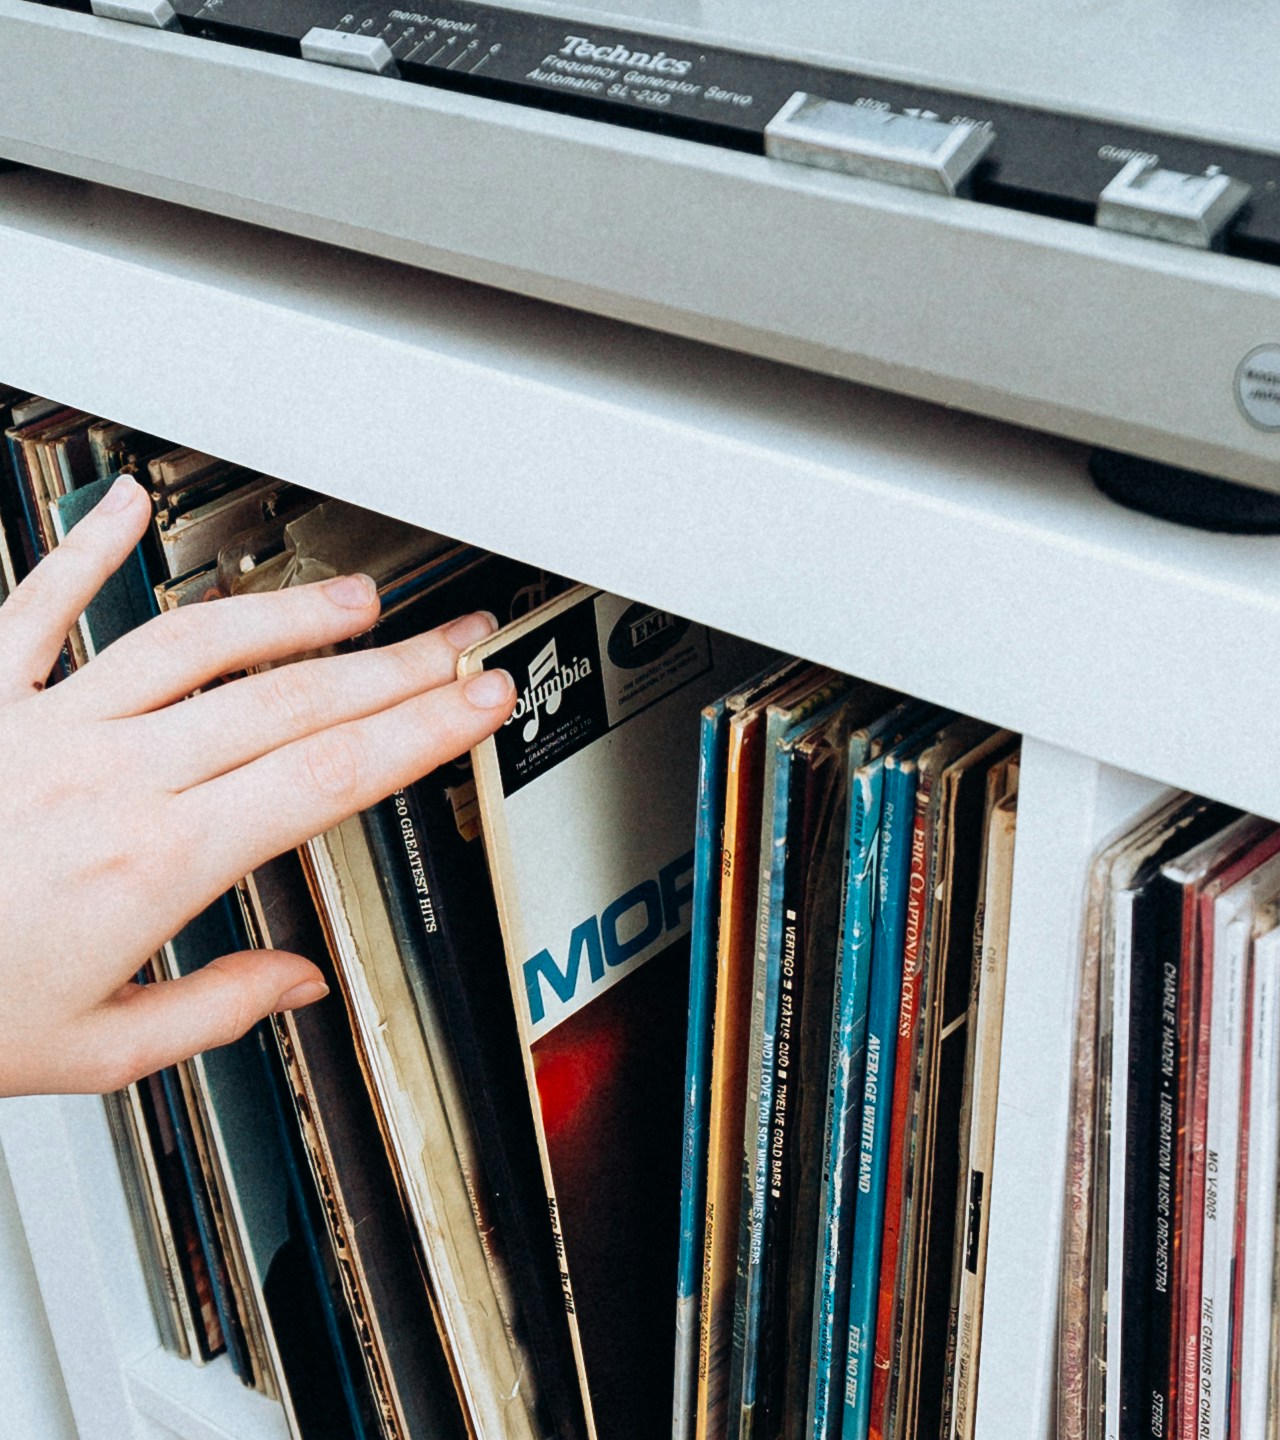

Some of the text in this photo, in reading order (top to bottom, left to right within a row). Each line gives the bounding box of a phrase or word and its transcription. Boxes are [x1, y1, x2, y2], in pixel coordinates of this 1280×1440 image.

[387, 8, 477, 34] memo-repeat
[489, 42, 503, 54] 6
[558, 35, 693, 76] Technics
[525, 67, 671, 106] Automatic SL-230
[540, 54, 753, 107] Frequency Generator Servo
[854, 95, 891, 113] stop
[503, 656, 593, 726] olumbia
[527, 733, 568, 763] GRAMOPHONE
[394, 797, 437, 933] 20 GREATEST HITS
[723, 848, 732, 878] CBS
[910, 828, 925, 871] ERIC
[758, 883, 771, 951] MERCURY
[761, 1032, 774, 1058] AND
[771, 925, 797, 1187] VERTIGO STATUS QUO TWELVE GOLD BARS
[759, 1066, 772, 1097] LOVE
[758, 1099, 771, 1125] YOU
[858, 1032, 881, 1193] AVERAGE WHITE BAND
[1154, 961, 1178, 1293] CHARLIE HADEN LIBERATION MUSIC ORCHESTRA
[755, 1148, 768, 1175] MIKE
[753, 1175, 767, 1220] SAMMES
[1206, 1149, 1218, 1221] MG V-8005
[750, 1220, 764, 1265] SINGERS
[699, 1221, 714, 1381] SIMON GARFUNKEL COLLECTION
[1202, 1295, 1215, 1322] THE
[845, 1324, 862, 1409] FEEL NO FRET
[1200, 1324, 1214, 1375] GENIUS
[1183, 1381, 1194, 1406] RED
[1199, 1377, 1212, 1396] OF
[1150, 1390, 1165, 1438] STEREO
